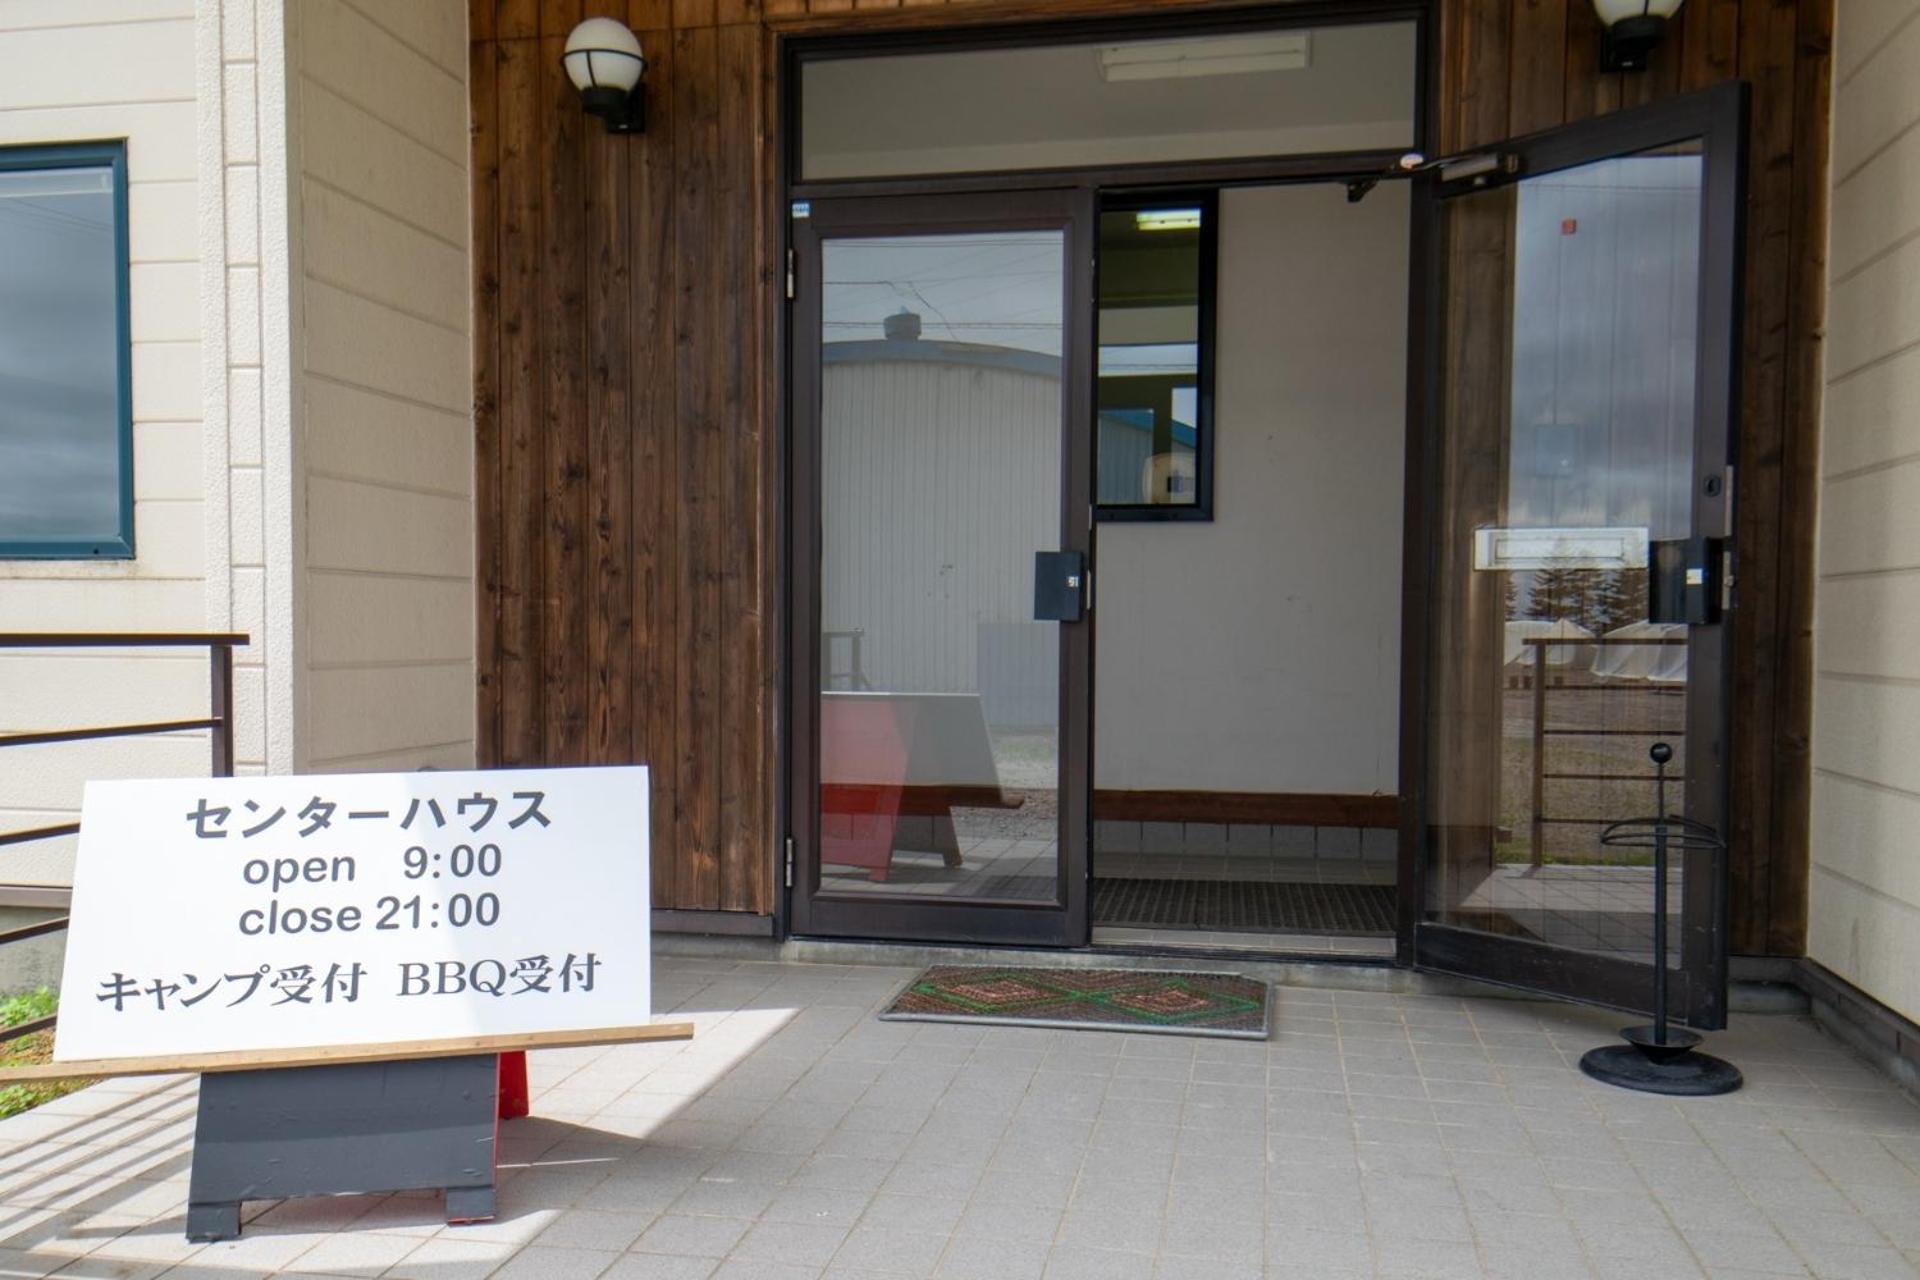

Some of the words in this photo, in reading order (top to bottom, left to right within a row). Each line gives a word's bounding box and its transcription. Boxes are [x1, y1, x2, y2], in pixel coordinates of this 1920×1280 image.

[186, 790, 551, 839] センターハウス
[243, 853, 355, 892] open
[403, 844, 502, 879] 9:00
[239, 899, 362, 936] close
[375, 892, 500, 931] 21:00
[97, 962, 368, 1012] キャンプ受付
[397, 952, 602, 998] BBQ受付
